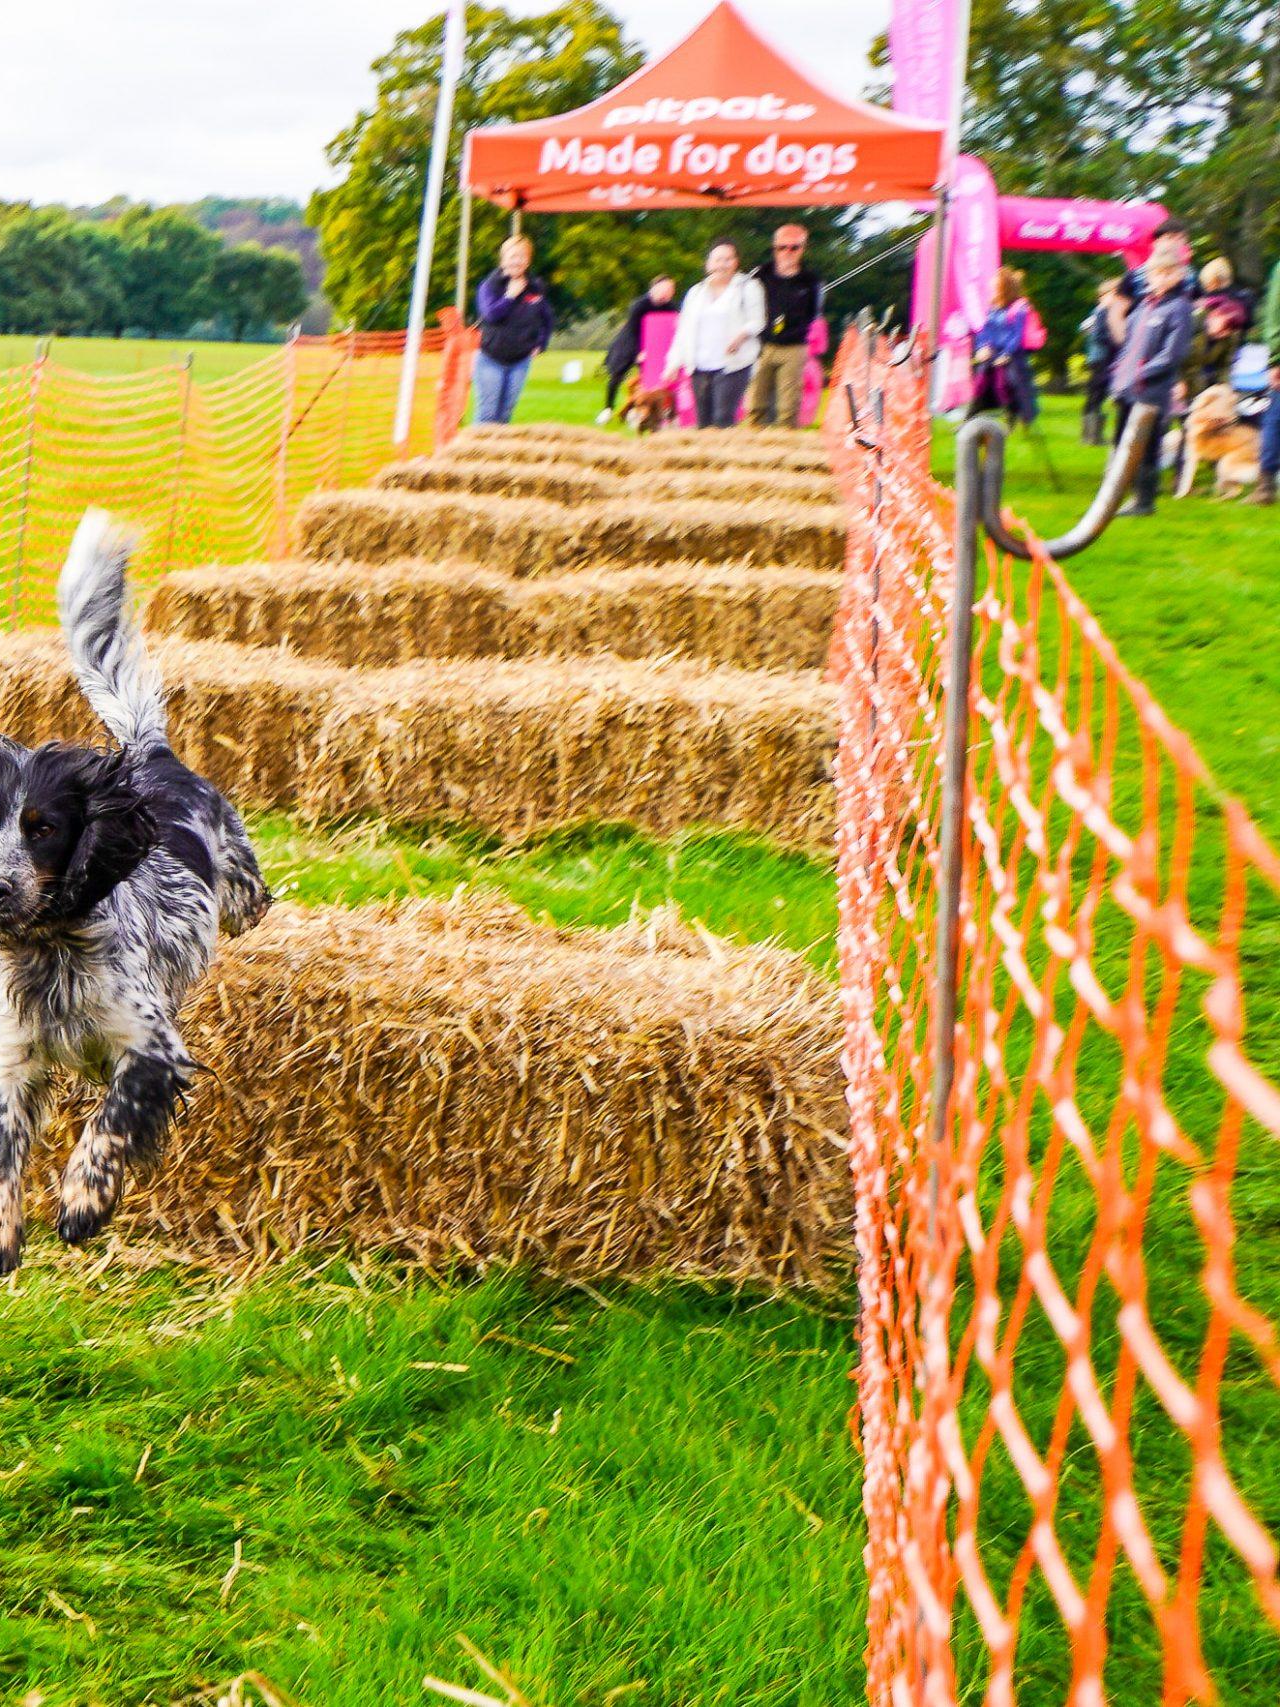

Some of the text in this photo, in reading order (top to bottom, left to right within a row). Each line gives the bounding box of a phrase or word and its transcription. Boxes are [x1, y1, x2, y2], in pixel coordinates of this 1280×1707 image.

[538, 133, 859, 182] Made for dogs
